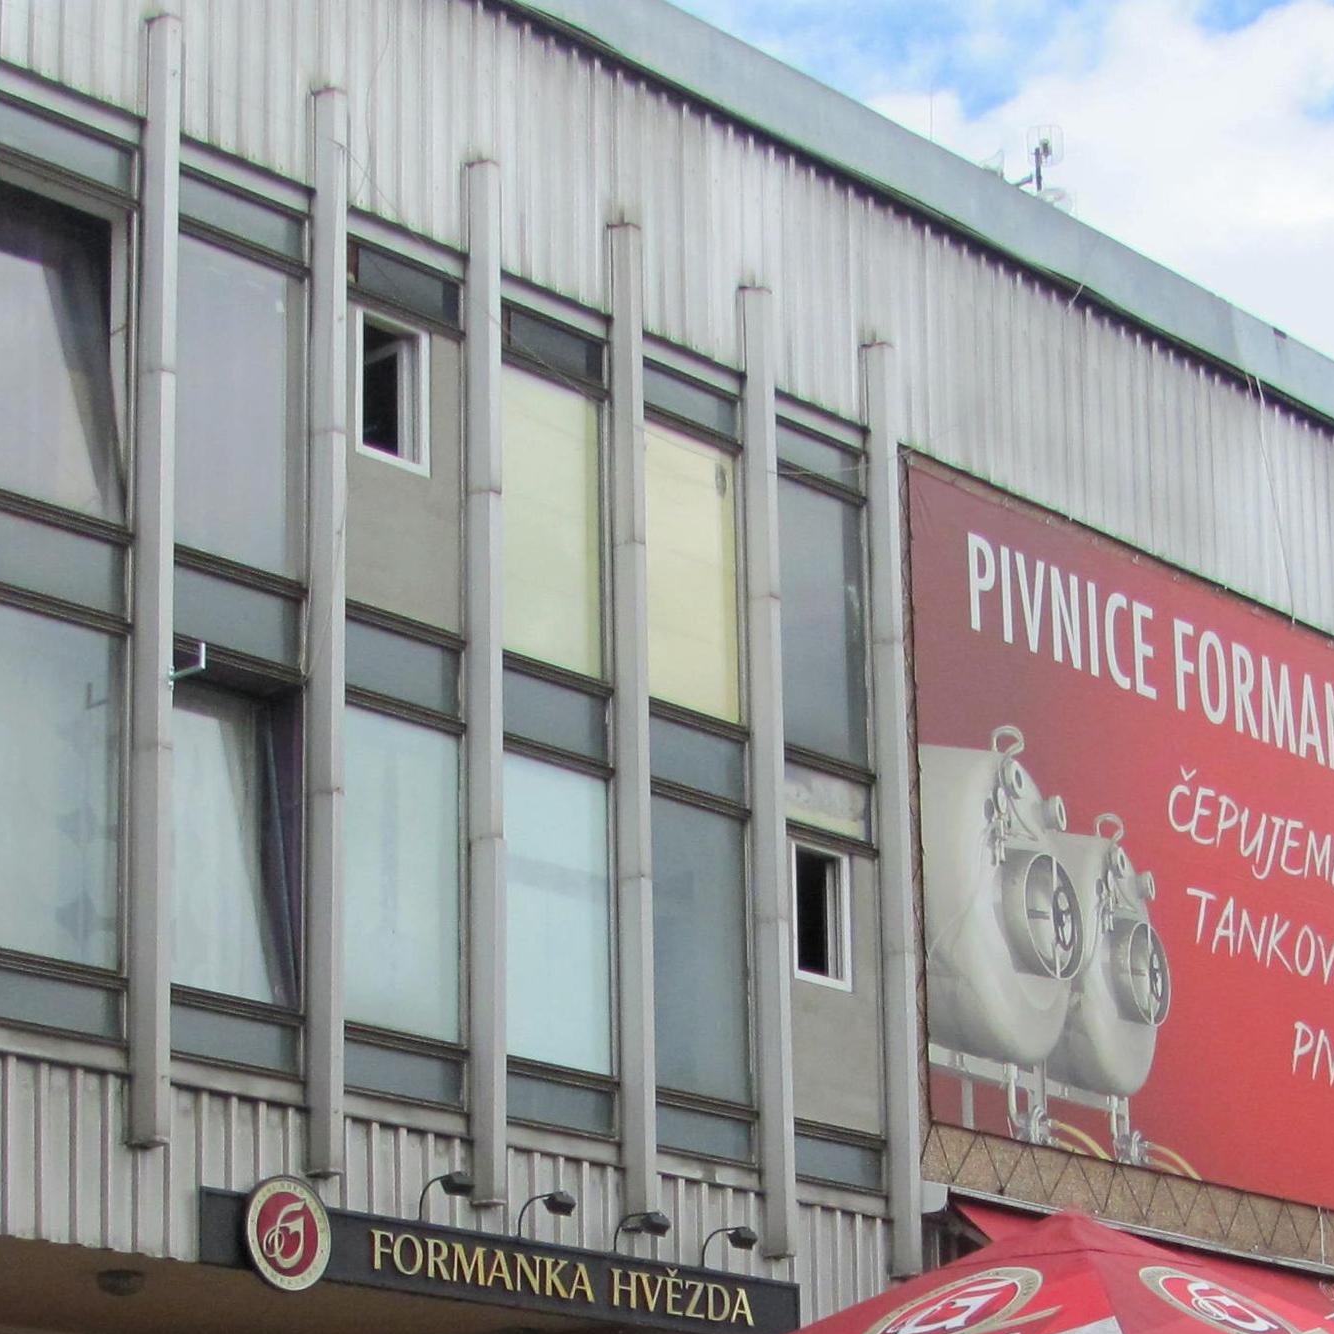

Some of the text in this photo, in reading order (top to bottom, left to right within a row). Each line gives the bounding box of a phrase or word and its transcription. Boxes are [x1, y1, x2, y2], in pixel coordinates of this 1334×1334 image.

[967, 532, 1157, 699] PIVNICE
[370, 1229, 595, 1303] FORMANKA
[611, 1267, 755, 1327] HVĚZDA
